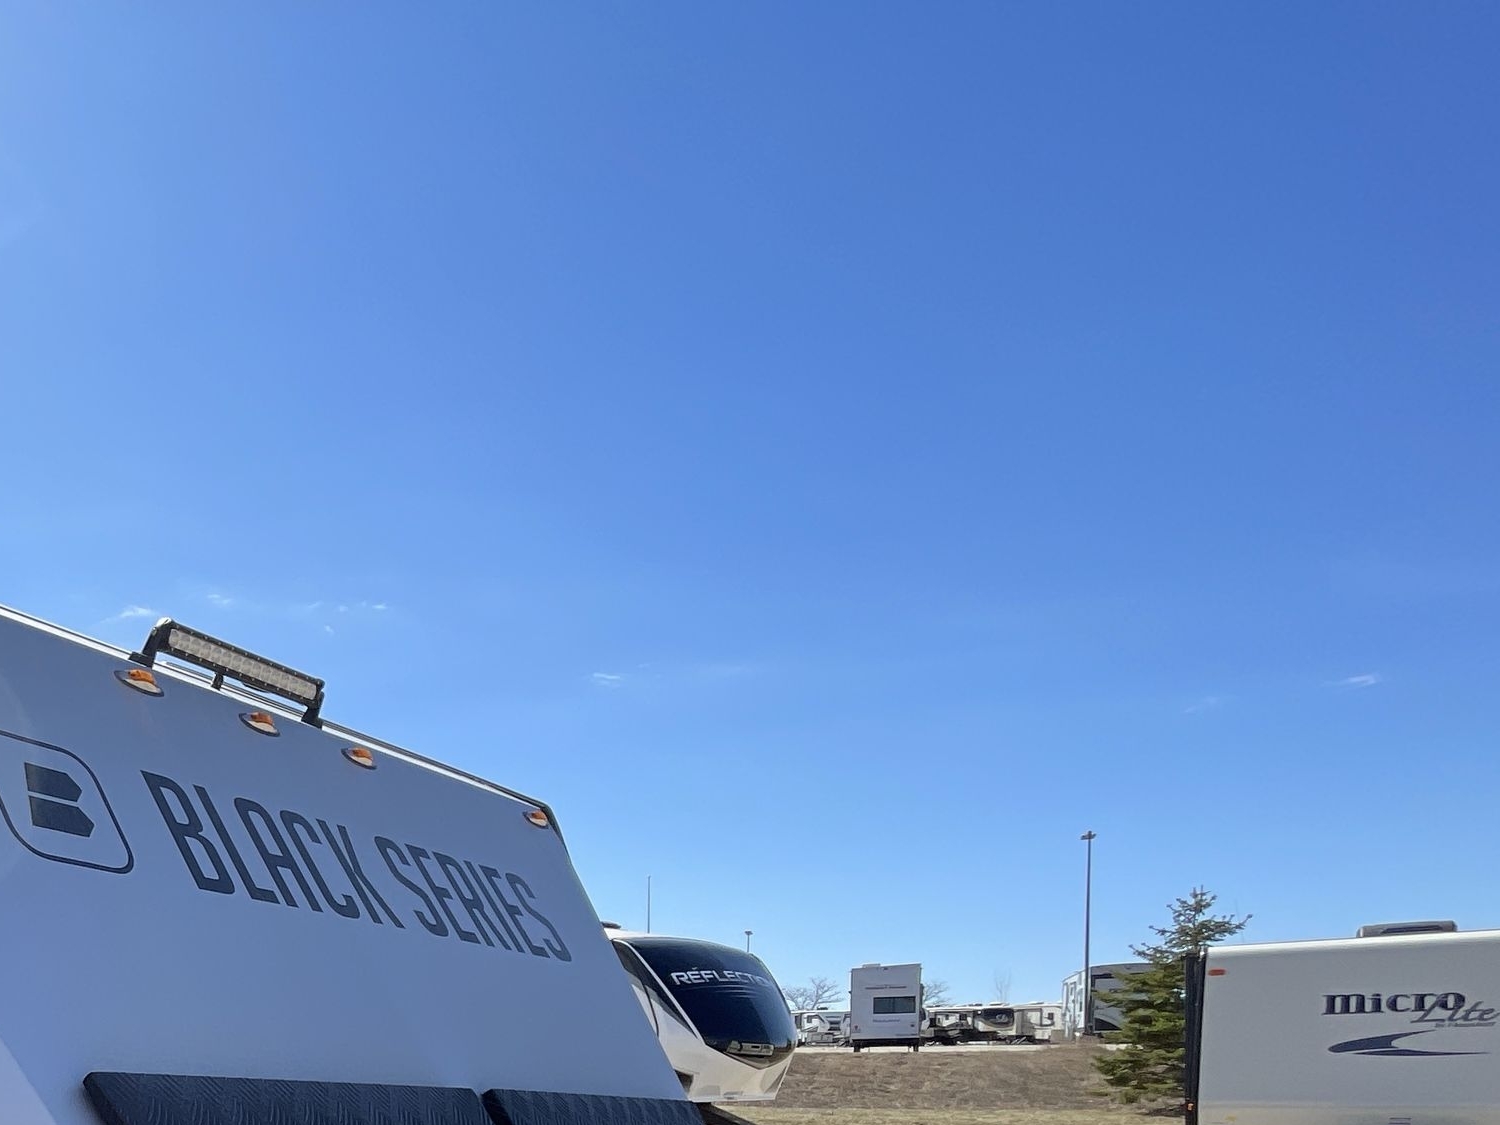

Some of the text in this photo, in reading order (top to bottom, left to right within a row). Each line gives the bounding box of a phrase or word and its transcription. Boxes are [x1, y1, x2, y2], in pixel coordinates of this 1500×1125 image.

[140, 769, 406, 930] BLACK
[373, 835, 573, 963] SERIES
[1321, 992, 1500, 1024] micro Lite
